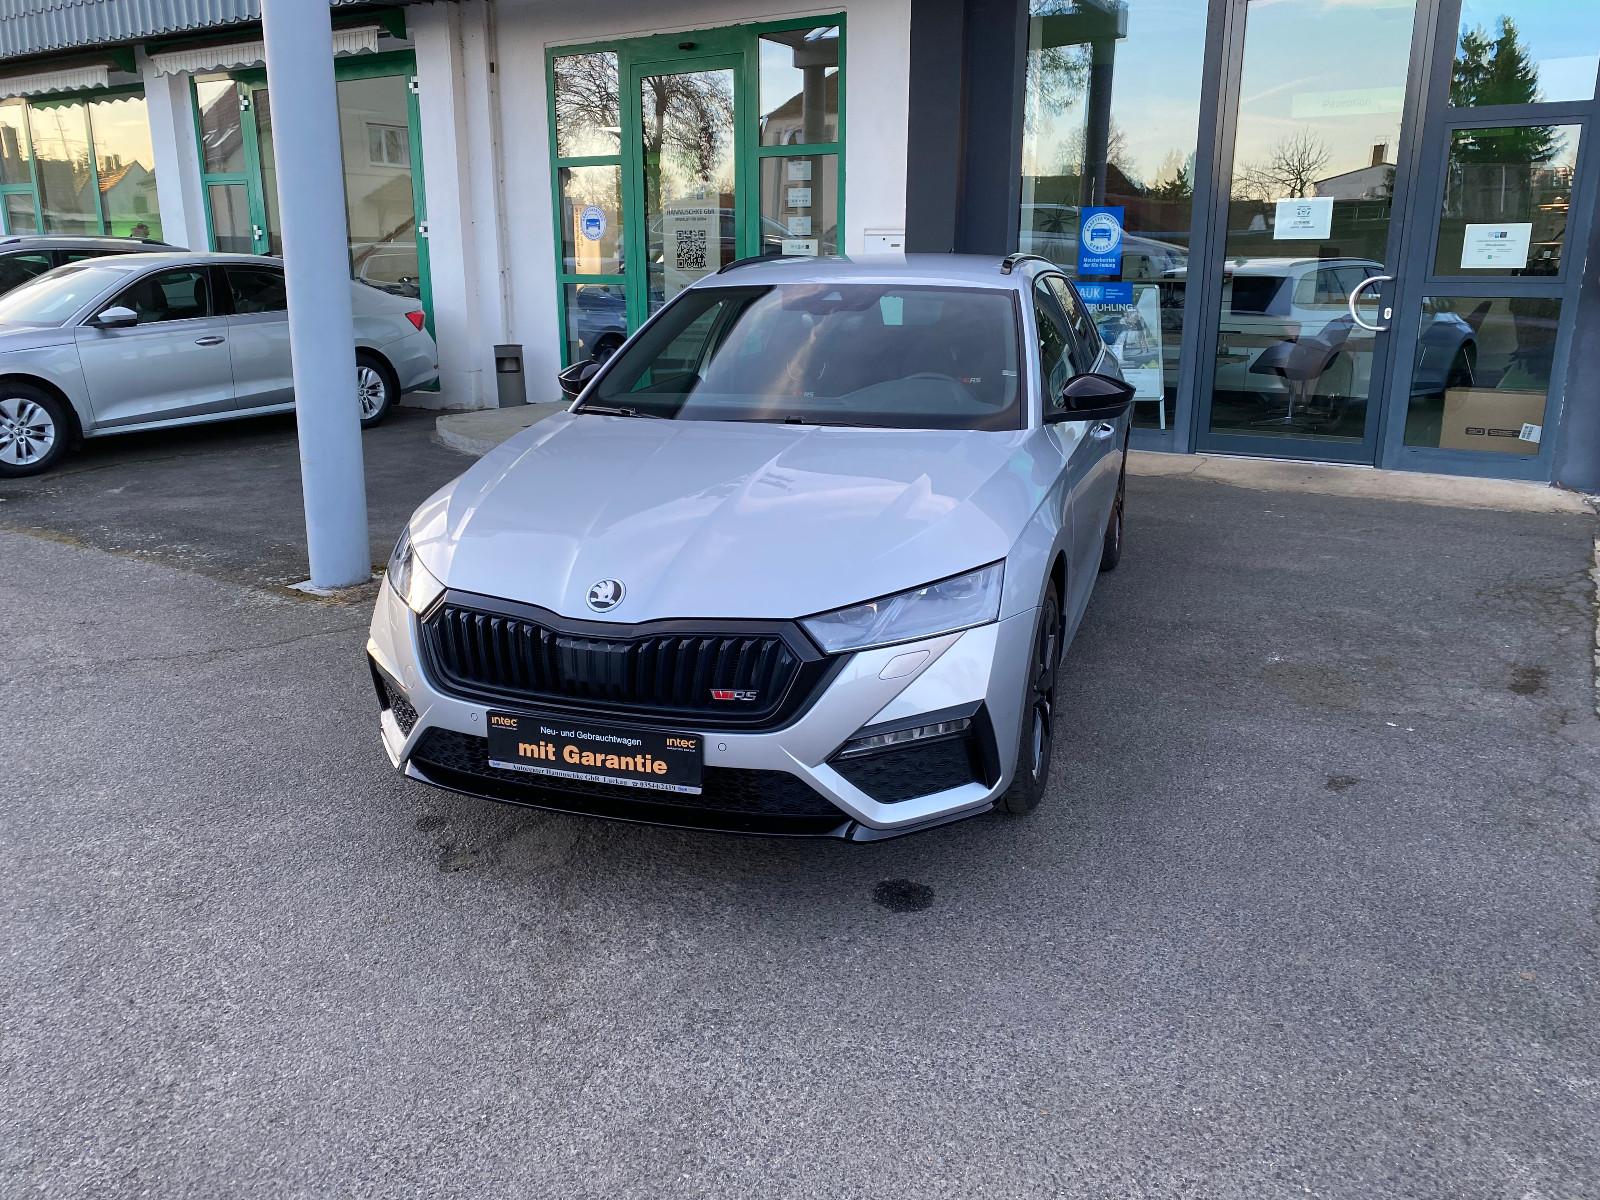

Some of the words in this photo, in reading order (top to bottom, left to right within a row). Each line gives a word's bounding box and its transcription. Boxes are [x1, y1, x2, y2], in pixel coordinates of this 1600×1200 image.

[540, 726, 558, 736] Neu-
[560, 730, 575, 738] und
[576, 730, 642, 747] Gebrauchtwagen
[666, 737, 697, 748] intec
[518, 740, 556, 761] mit
[562, 744, 668, 775] Garantie
